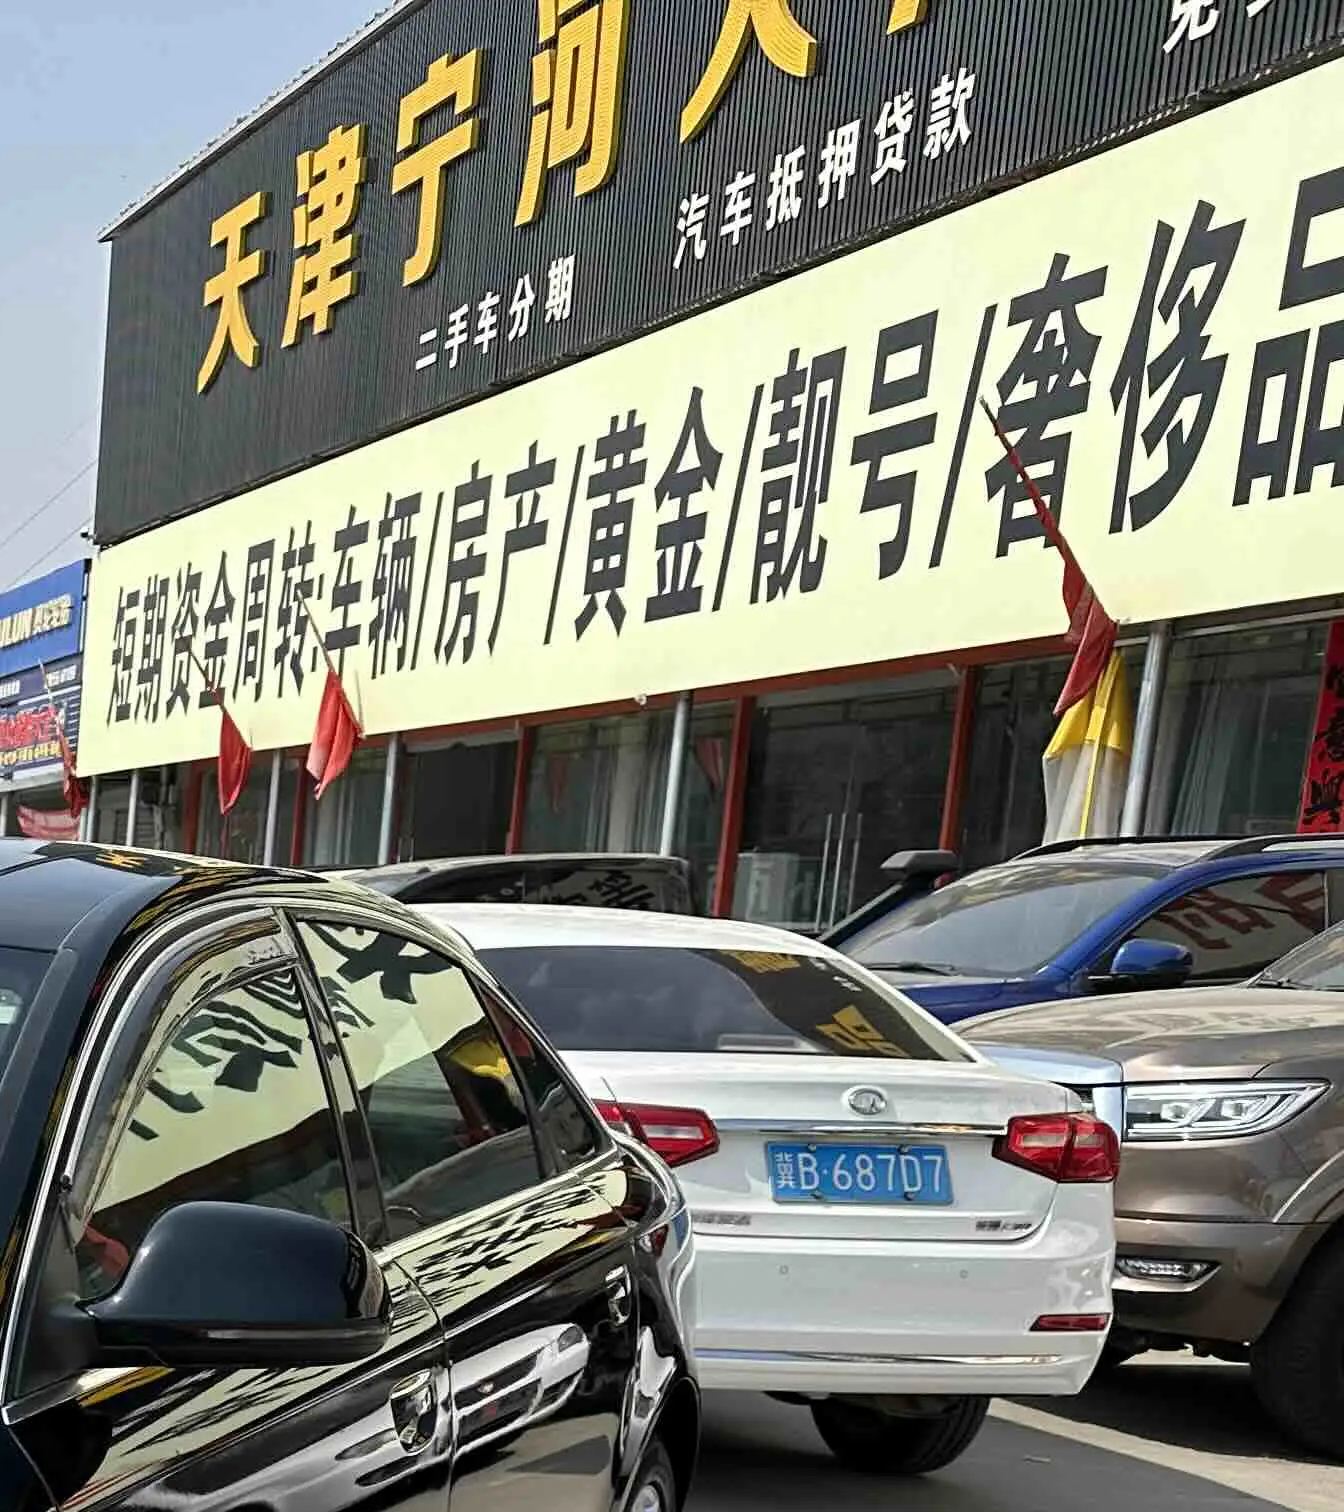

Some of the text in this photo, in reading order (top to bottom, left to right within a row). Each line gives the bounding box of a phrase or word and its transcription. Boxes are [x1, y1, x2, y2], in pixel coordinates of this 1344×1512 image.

[197, 0, 931, 394] 天津宁河
[673, 66, 978, 270] 汽车抵押贷款
[415, 253, 576, 371] 二手车分期
